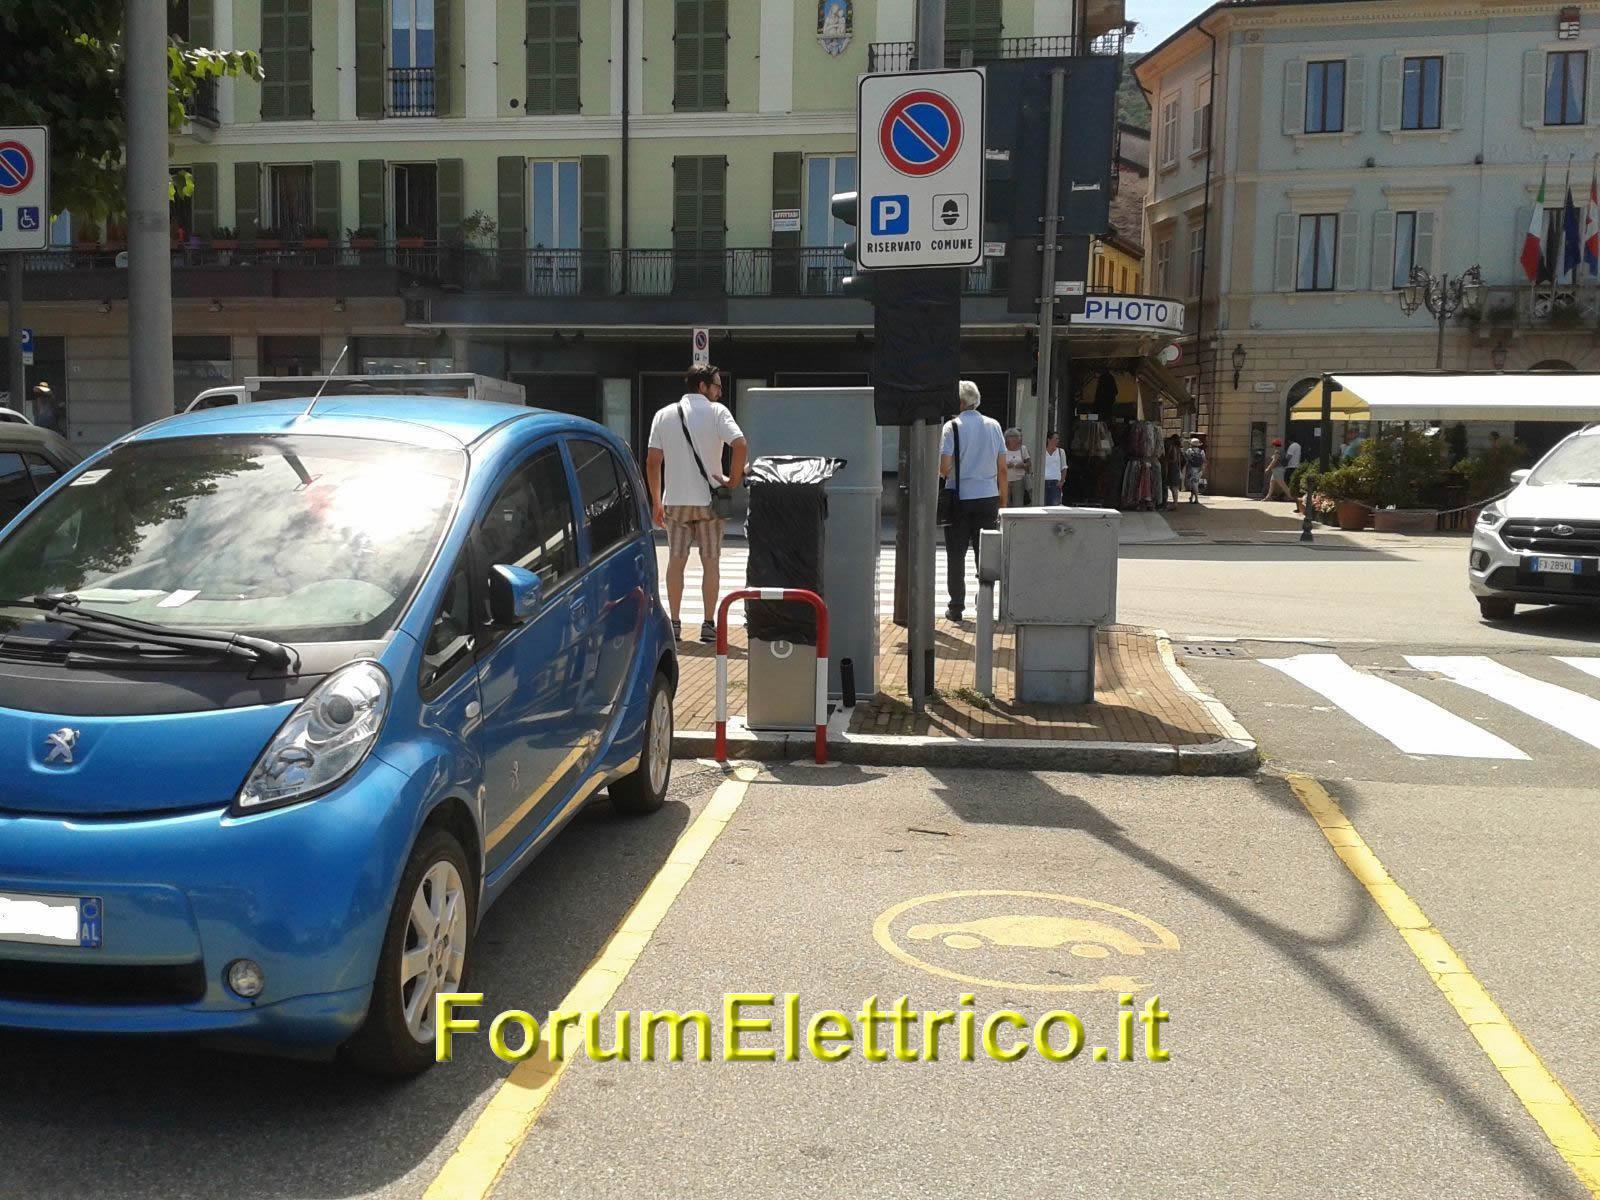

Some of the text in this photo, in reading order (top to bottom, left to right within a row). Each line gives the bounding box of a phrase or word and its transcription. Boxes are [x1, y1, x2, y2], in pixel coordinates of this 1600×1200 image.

[879, 200, 901, 231] P
[867, 240, 921, 253] RISERVATO
[931, 239, 973, 250] COMUNE
[1085, 300, 1168, 322] PHOTO
[82, 922, 100, 940] AL
